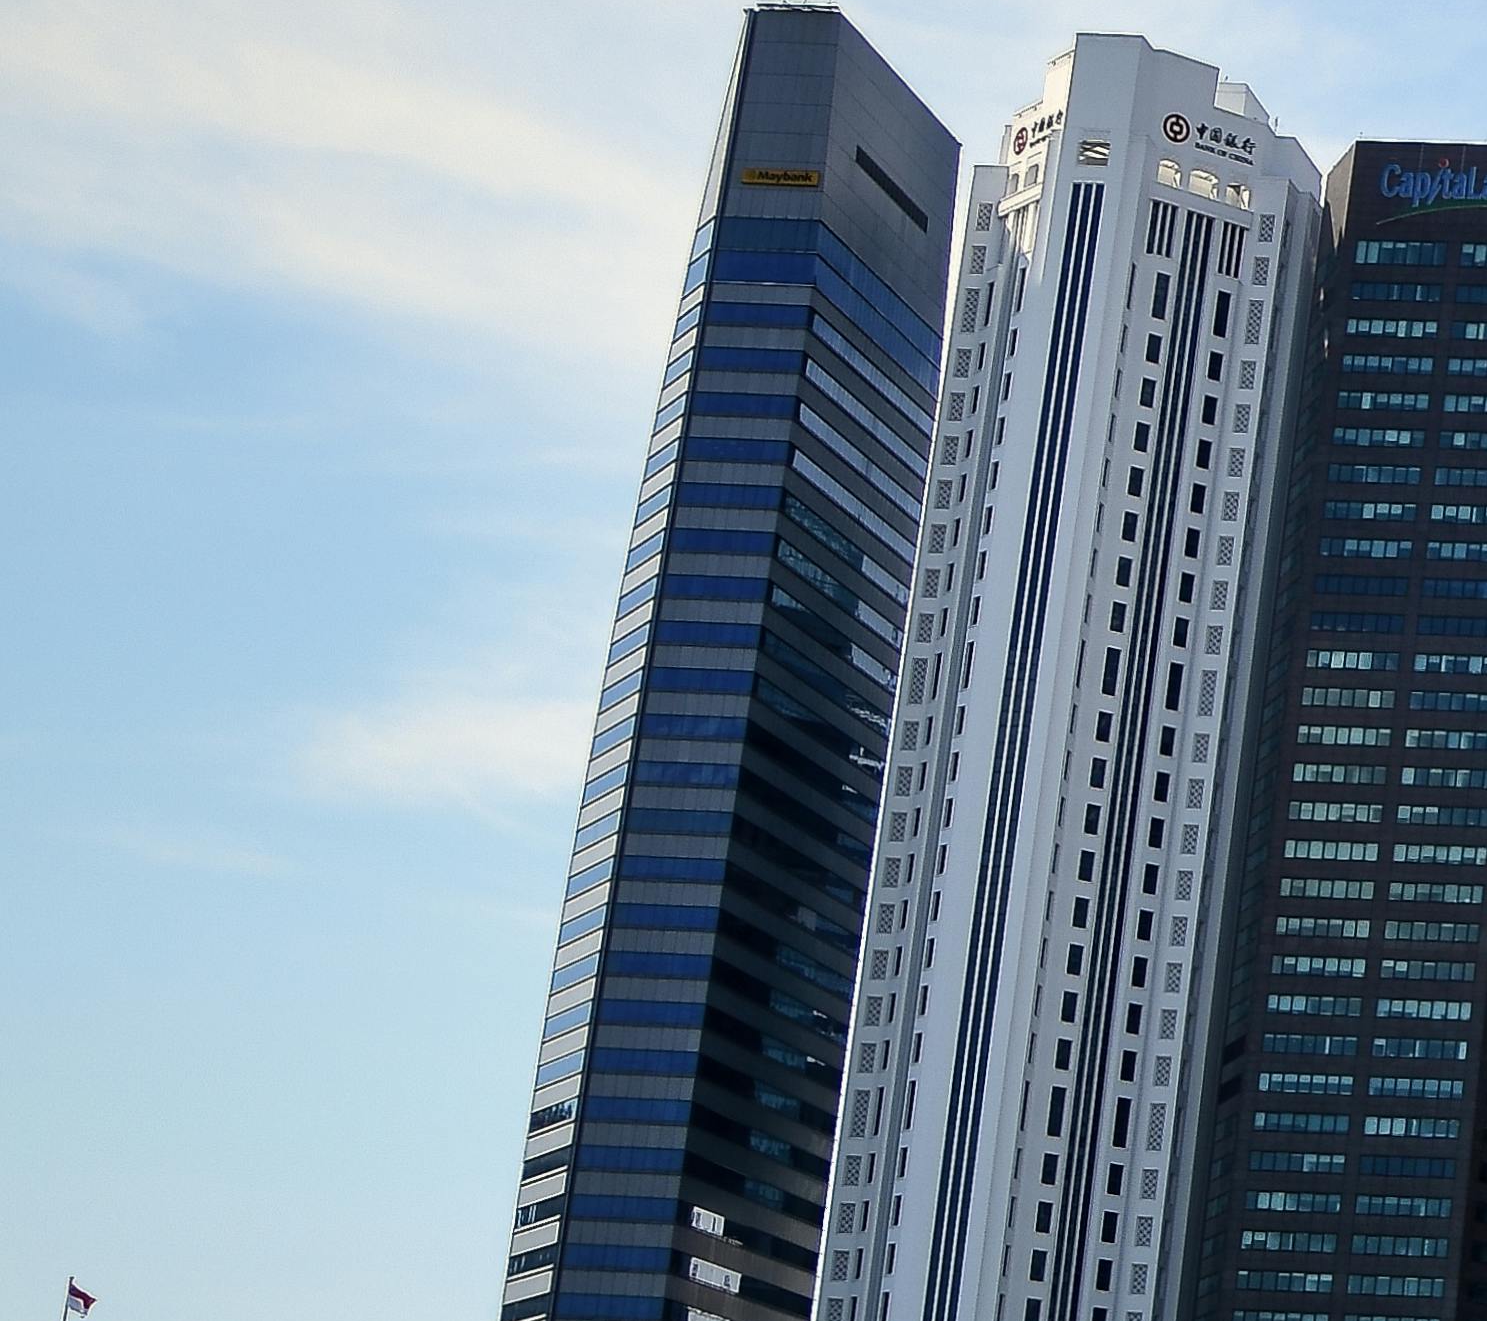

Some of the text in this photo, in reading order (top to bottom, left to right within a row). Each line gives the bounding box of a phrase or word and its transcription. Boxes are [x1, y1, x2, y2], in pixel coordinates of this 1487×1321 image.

[1194, 141, 1255, 167] BANK OF CHINA
[757, 170, 813, 183] Maybank
